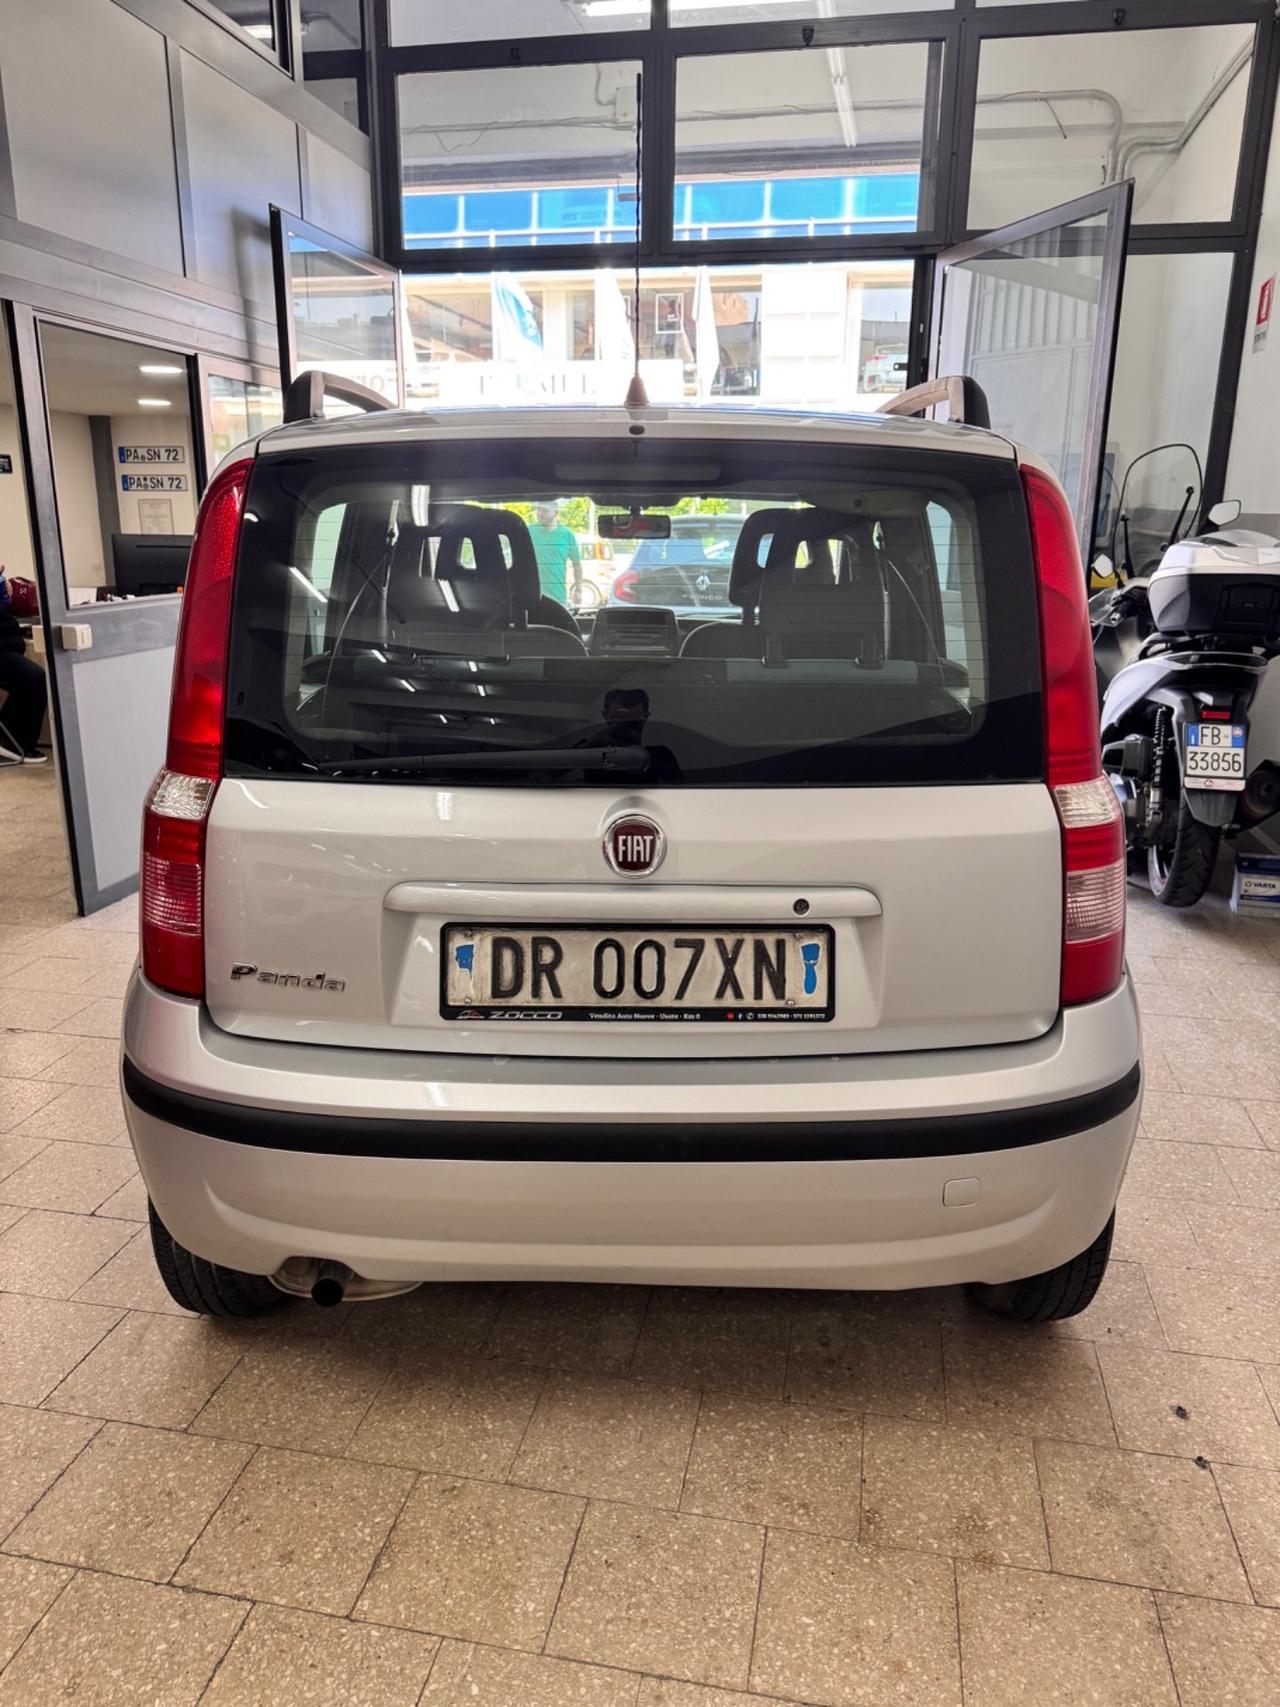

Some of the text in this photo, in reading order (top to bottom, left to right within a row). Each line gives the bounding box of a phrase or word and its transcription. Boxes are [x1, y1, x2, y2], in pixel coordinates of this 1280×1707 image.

[125, 448, 179, 461] PA SN 72
[128, 476, 182, 489] PA SN 72
[1200, 725, 1221, 746] FB
[1188, 750, 1242, 773] 33856
[618, 835, 654, 862] FIAT
[229, 962, 346, 993] Panda
[490, 935, 787, 1001] DR 007XN
[488, 1010, 563, 1020] ZOCCO
